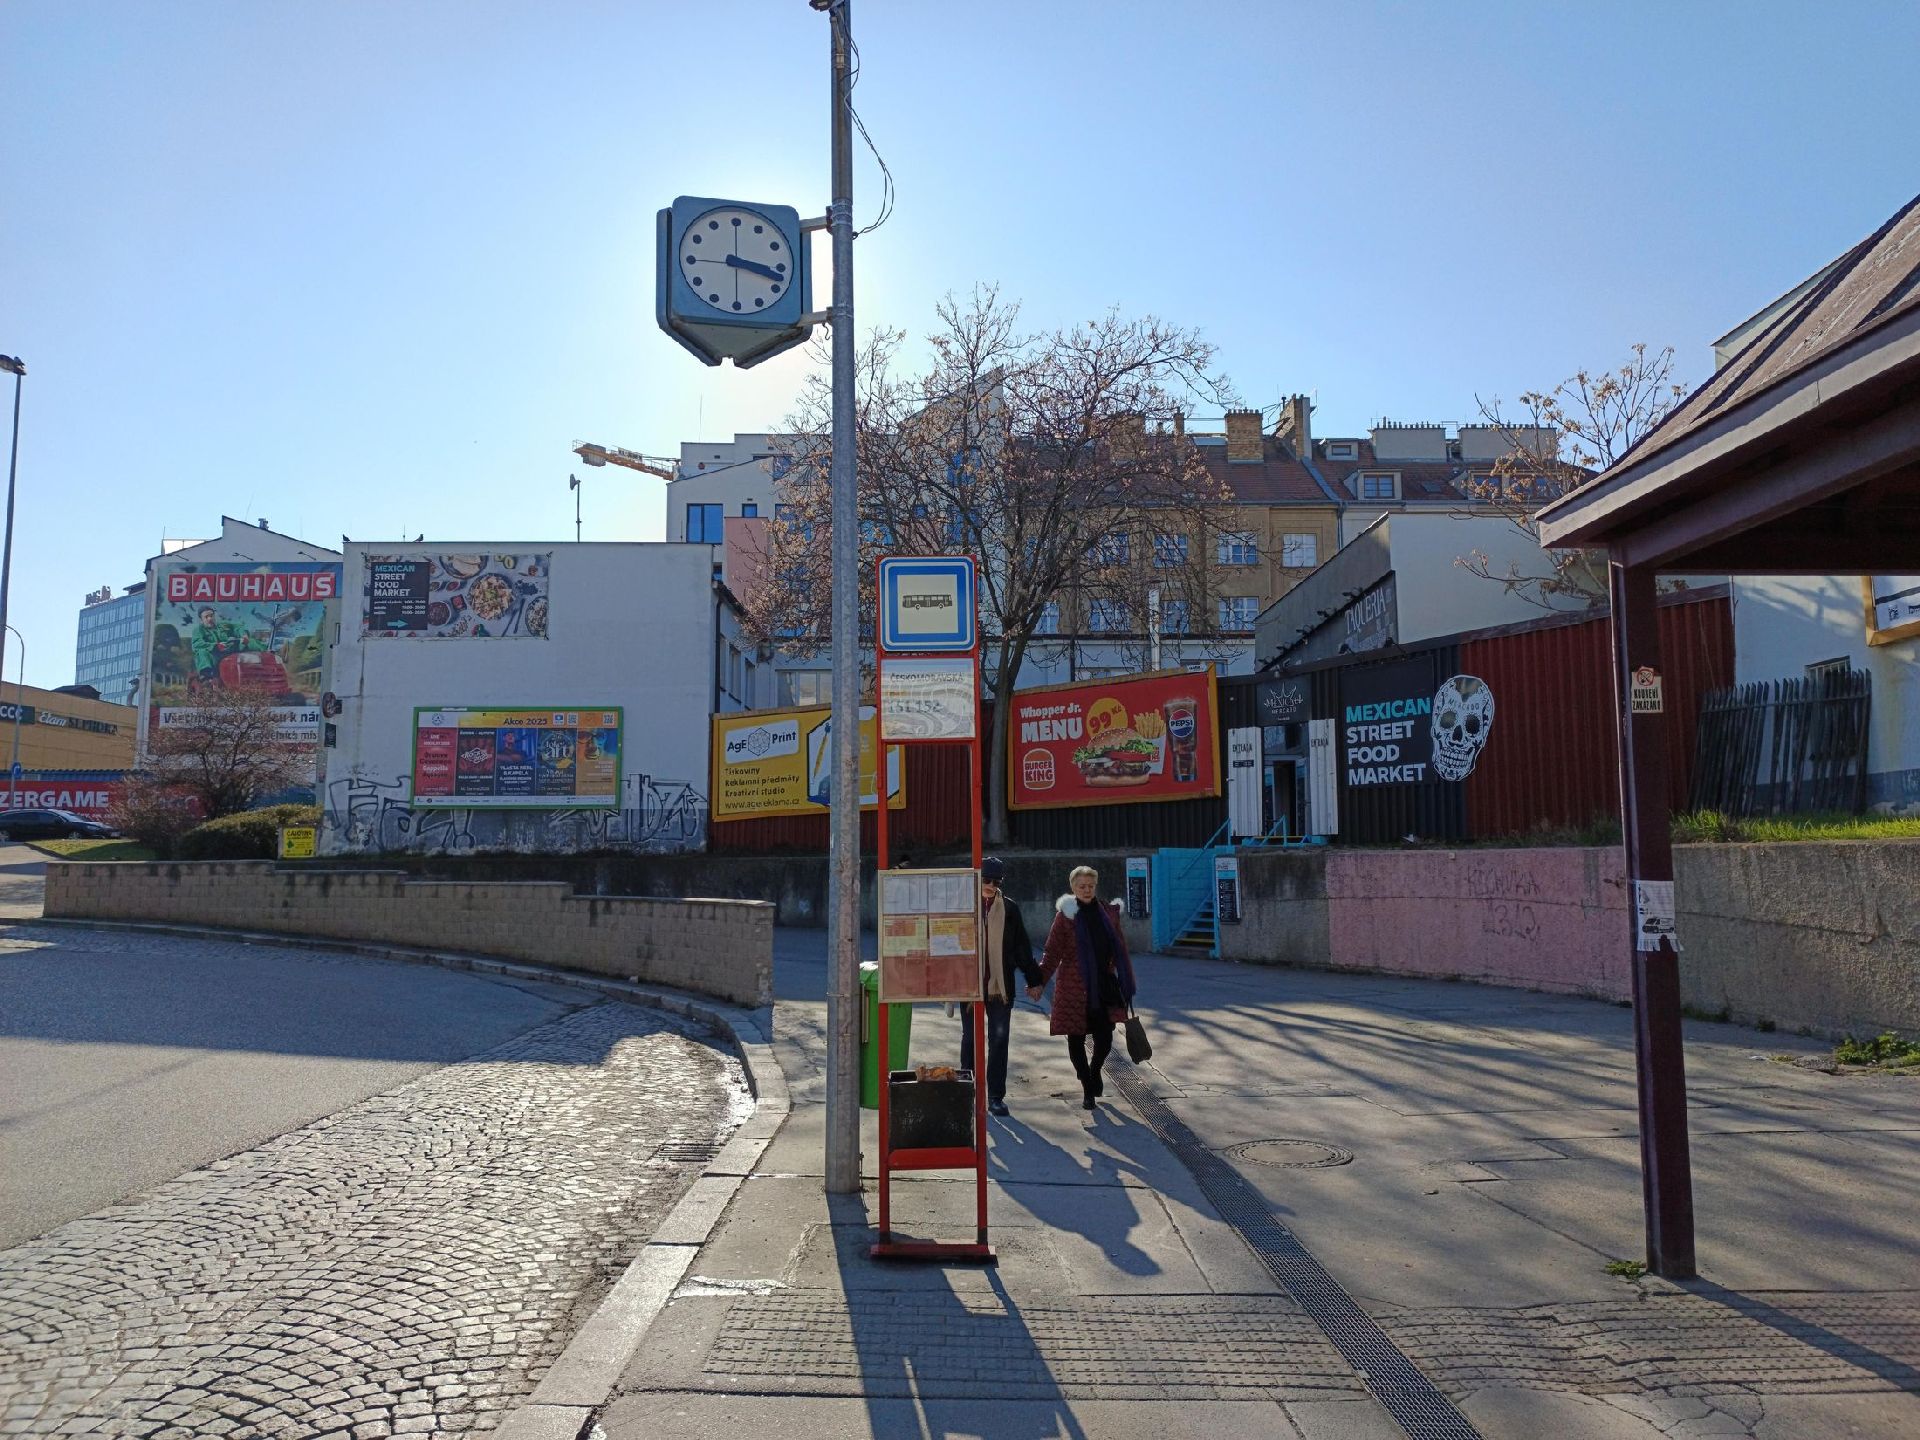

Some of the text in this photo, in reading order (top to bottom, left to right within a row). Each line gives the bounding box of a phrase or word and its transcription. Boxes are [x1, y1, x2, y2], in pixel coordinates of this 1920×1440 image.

[171, 576, 332, 597] BAUHAUS
[374, 581, 399, 589] FOOD
[374, 588, 410, 597] MARKET
[1345, 587, 1386, 634] TAQUERIA
[1020, 702, 1082, 718] Whopper Jr.
[1346, 697, 1430, 723] MEXICAN
[39, 711, 67, 727] Etam
[1089, 711, 1112, 734] 99
[1170, 719, 1193, 727] PEPSI
[1021, 717, 1083, 744] MENU
[1347, 720, 1414, 744] STREET
[727, 731, 797, 753] AgE Print
[1348, 744, 1400, 765] FOOD
[724, 767, 760, 775] Tiskoviny
[1024, 760, 1053, 771] BURGER
[725, 775, 800, 787] Reklamní předměty
[1025, 769, 1054, 782] KING
[1349, 763, 1426, 786] MARKET
[725, 787, 785, 797] Kreativní studio
